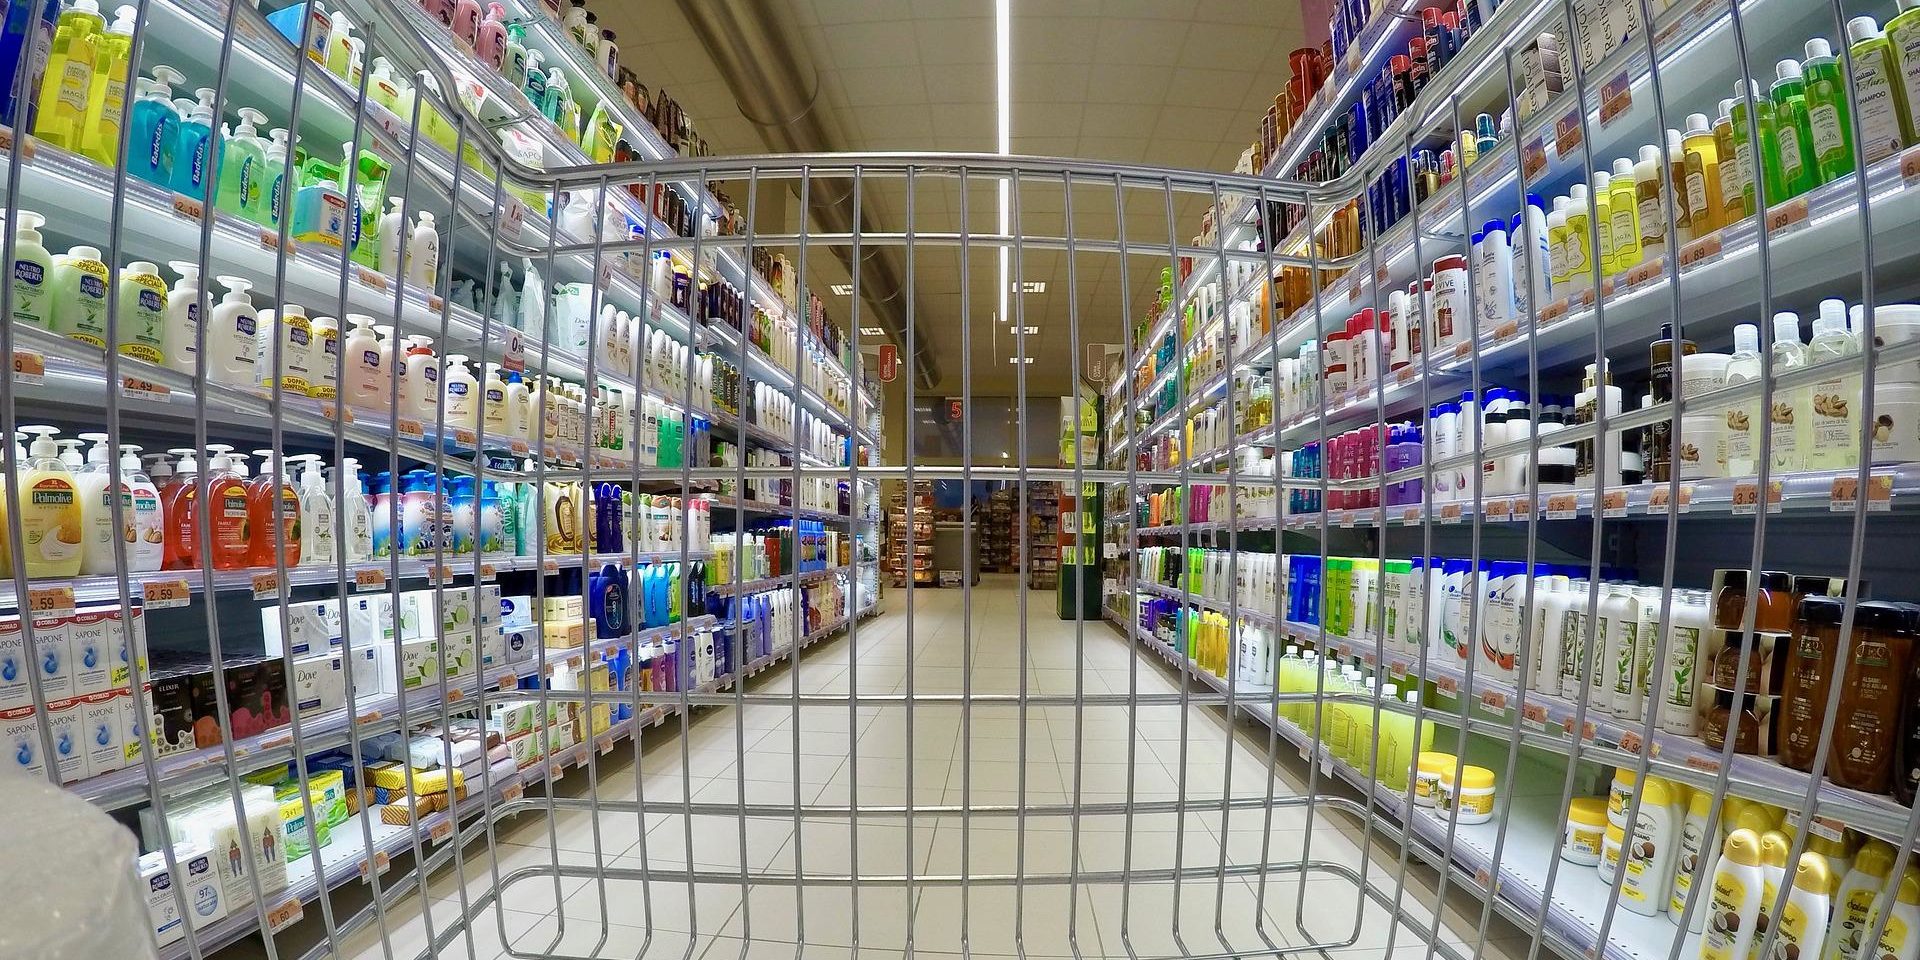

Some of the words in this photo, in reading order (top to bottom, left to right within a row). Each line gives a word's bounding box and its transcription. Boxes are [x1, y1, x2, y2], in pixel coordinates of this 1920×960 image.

[1858, 90, 1886, 105] SHAMPOO
[151, 121, 163, 165] Badedas
[192, 142, 204, 183] Badedas
[18, 262, 42, 273] NEUTRO
[15, 269, 43, 281] ROBERTS
[83, 278, 103, 288] NEUTRO
[131, 346, 156, 356] DOPPIA
[127, 377, 153, 392] 2.49
[951, 402, 962, 418] 5
[33, 491, 73, 503] Palmolive
[256, 580, 277, 592] 2.59
[359, 575, 376, 585] 3.68
[150, 589, 173, 601] 2.59
[41, 618, 59, 626] CONAD
[80, 614, 98, 622] CONAD
[35, 634, 64, 645] SAPONE
[75, 629, 101, 640] SAPONE
[403, 651, 419, 662] Dove
[298, 670, 318, 682] Dove
[158, 683, 179, 693] ELIXIR
[54, 699, 72, 708] CONAD
[13, 707, 31, 716] CONAD
[88, 706, 114, 719] SAPONE
[49, 714, 77, 727] SAPONE
[6, 723, 37, 737] SAPONE
[285, 807, 298, 819] 3+1
